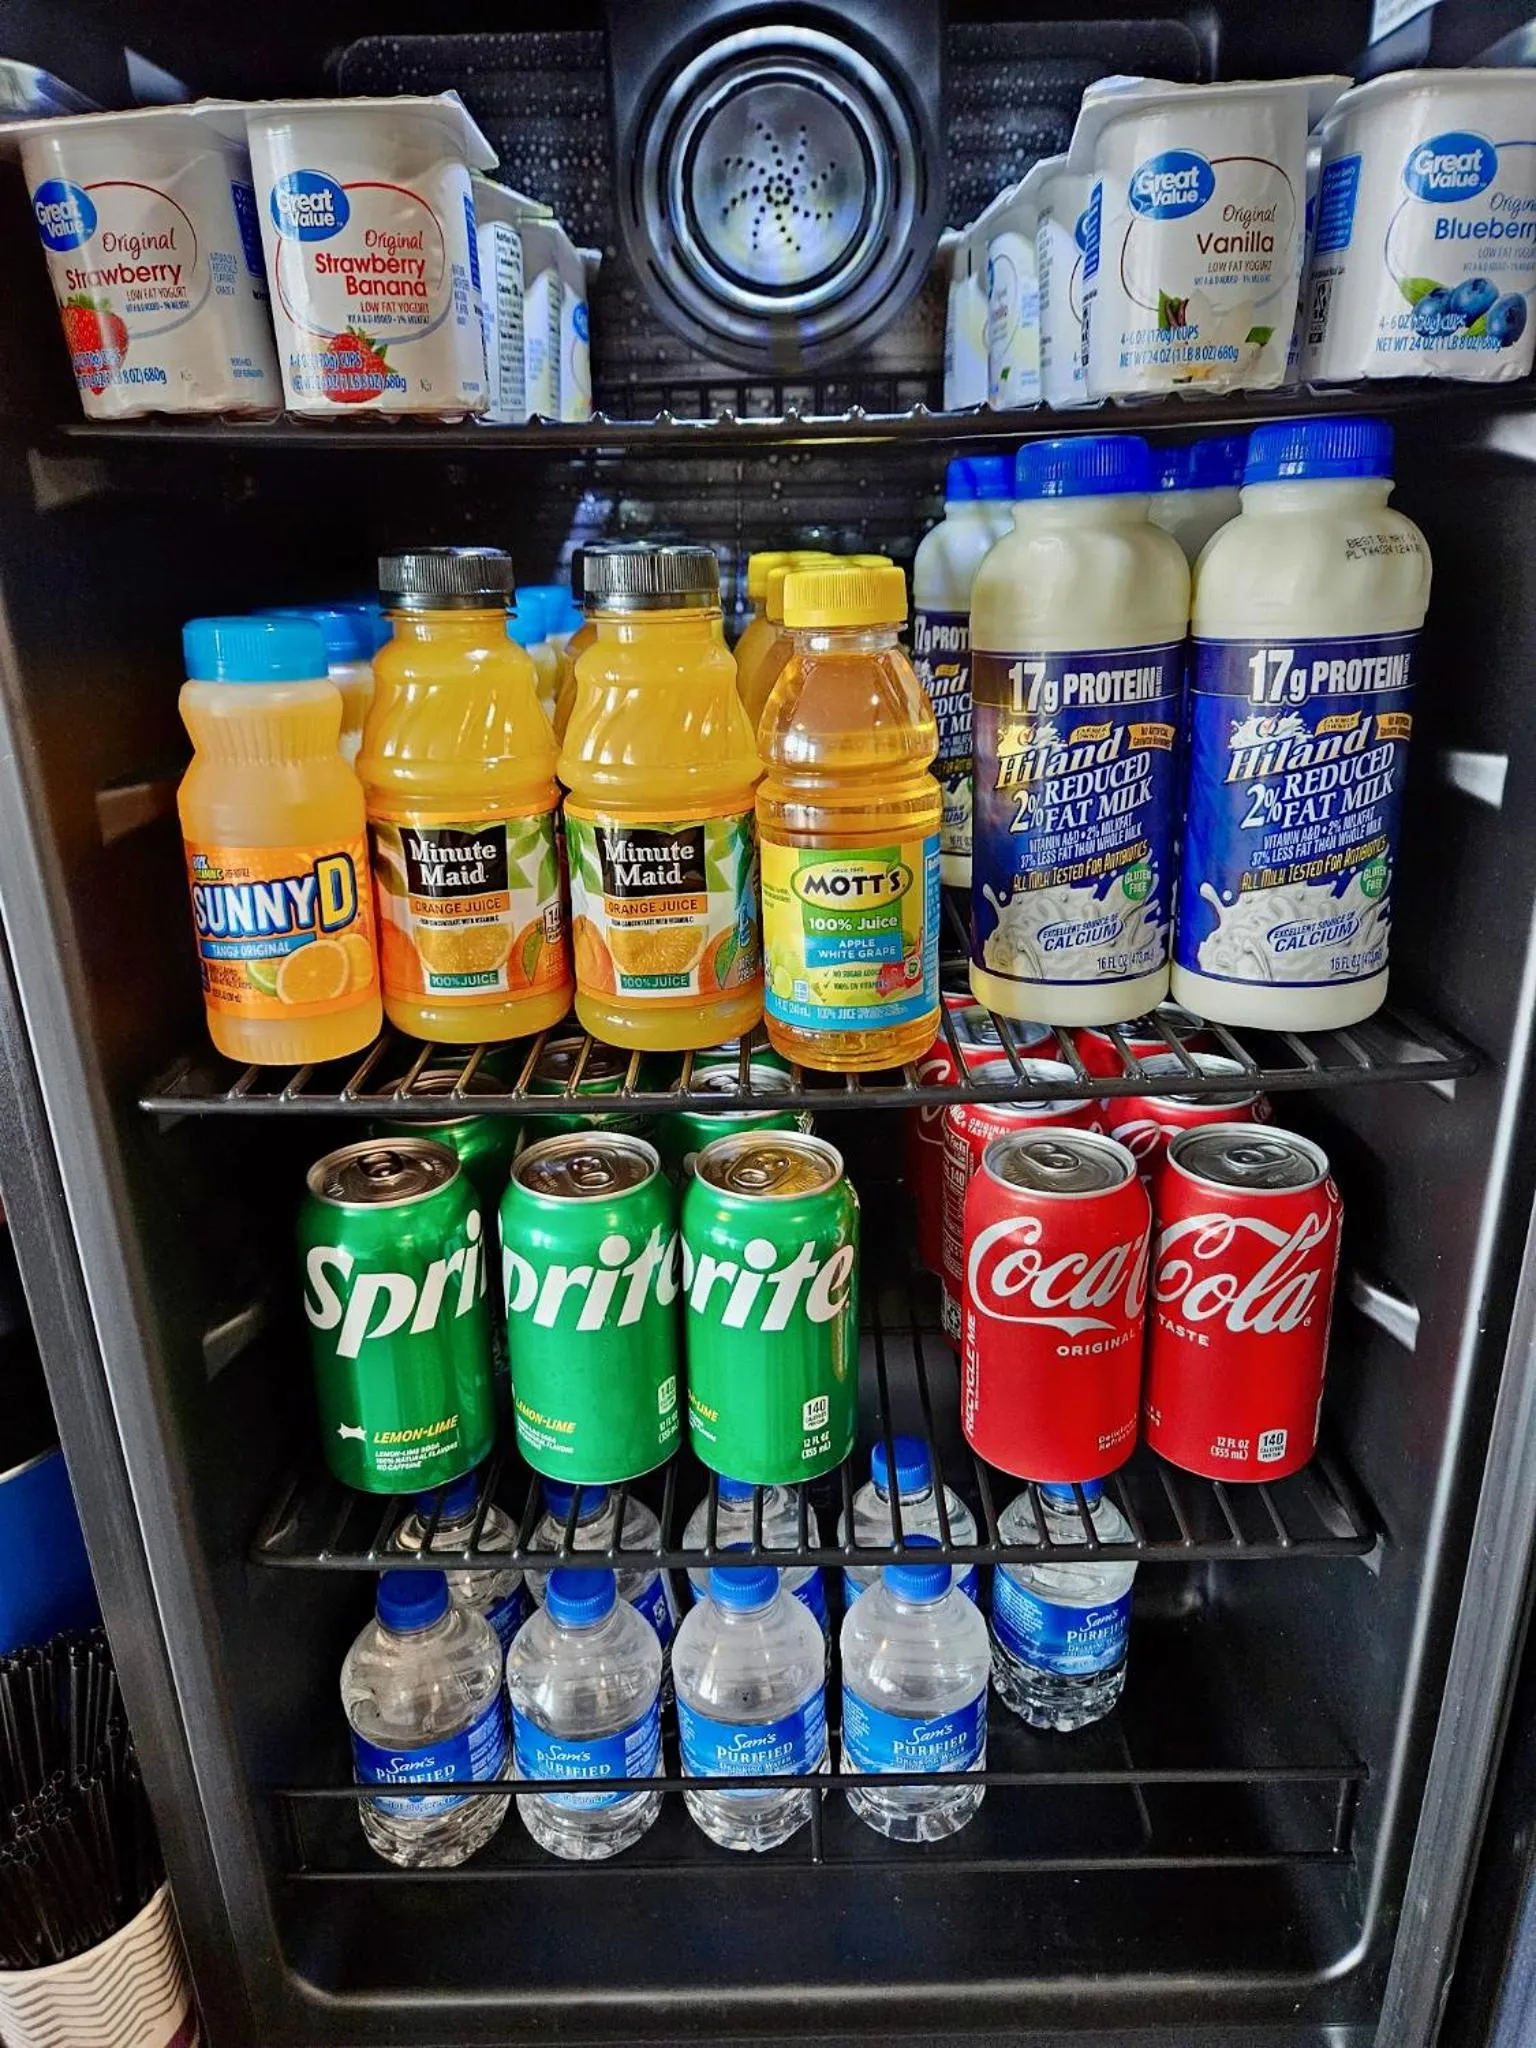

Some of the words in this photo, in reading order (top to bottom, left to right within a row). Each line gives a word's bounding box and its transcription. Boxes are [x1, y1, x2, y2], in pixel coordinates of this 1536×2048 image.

[1415, 149, 1483, 173] Great
[1138, 167, 1200, 193] Great
[1429, 172, 1479, 189] Value
[277, 188, 334, 213] Great
[1151, 186, 1199, 206] Value
[36, 195, 82, 225] Great
[289, 207, 336, 229] Value
[1223, 203, 1278, 229] Original
[102, 227, 178, 260] Original
[364, 228, 424, 256] Original
[1196, 231, 1275, 256] Vanilla
[65, 262, 183, 292] Strawberry
[315, 252, 426, 277] Strawberry
[1208, 261, 1228, 273] LOW
[1228, 261, 1243, 272] FAT
[1244, 260, 1273, 272] YOGURT
[126, 289, 141, 302] LOW
[157, 286, 187, 300] YOGURT
[346, 275, 428, 298] Banana
[361, 302, 380, 314] LOW
[382, 302, 397, 314] FAT
[398, 302, 430, 314] YOGURT
[1160, 348, 1171, 364] OZ
[1183, 347, 1194, 363] LB
[1195, 346, 1201, 361] 8
[1376, 337, 1392, 352] NET
[1409, 337, 1422, 351] 24
[1423, 337, 1435, 350] OZ
[144, 366, 167, 385] 680g
[932, 625, 968, 650] PROT
[1009, 661, 1059, 713] 17g
[1063, 667, 1156, 705] PROTEIN
[1249, 649, 1306, 704] 17g
[1310, 654, 1404, 694] PROTEIN
[994, 726, 1124, 790] Hiland
[1226, 714, 1373, 784] Hiland
[1043, 752, 1151, 806] REDUCED
[1282, 742, 1394, 803] REDUCED
[1042, 799, 1095, 835] FAT
[1096, 776, 1154, 821] MILK
[1240, 783, 1283, 831] 2%
[1281, 793, 1338, 830] FAT
[1340, 767, 1396, 814] MILK
[1009, 790, 1044, 834] 2%
[1061, 829, 1080, 848] A&D
[1086, 825, 1100, 841] 2%
[1251, 850, 1270, 867] 37%
[1272, 845, 1294, 864] LESS
[1295, 840, 1313, 859] FAT
[1314, 835, 1337, 855] THAN
[1338, 824, 1366, 847] WHOLE
[1264, 829, 1300, 851] VITAMIN
[1300, 824, 1321, 843] A&D
[1327, 818, 1342, 836] 2%
[409, 838, 497, 863] Minute
[604, 839, 695, 863] Minute
[1020, 854, 1036, 870] 37%
[1037, 849, 1057, 866] LESS
[1057, 844, 1073, 861] FAT
[1074, 840, 1096, 858] THAN
[1097, 830, 1124, 851] WHOLE
[421, 862, 487, 887] Maid
[615, 863, 683, 887] Maid
[1052, 862, 1085, 886] TESTED
[1086, 858, 1103, 878] FOR
[1288, 858, 1323, 883] TESTED
[1324, 853, 1344, 874] FOR
[803, 870, 902, 896] MOTT'S
[415, 900, 462, 914] ORANGE
[465, 897, 501, 913] JUICE
[608, 901, 656, 914] ORANGE
[659, 899, 698, 912] JUICE
[809, 916, 853, 931] 100%
[858, 915, 898, 931] Juice
[1042, 923, 1082, 939] EXCELLENT
[1274, 922, 1316, 939] EXCELLENT
[241, 940, 292, 957] ORIGINAL
[839, 938, 875, 950] APPLE
[1043, 922, 1117, 952] CALCIUM
[1274, 921, 1354, 953] CALCIUM
[818, 949, 855, 960] WHITE
[858, 945, 896, 958] GRAPE
[1096, 957, 1107, 971] 16
[1108, 956, 1117, 969] FL
[1330, 957, 1340, 971] 16
[1341, 957, 1350, 970] FL
[432, 975, 460, 987] 100%
[461, 973, 498, 986] JUICE
[622, 977, 651, 988] 100%
[653, 975, 688, 987] JUICE
[498, 1222, 679, 1331] prit
[1154, 1209, 1332, 1335] Cola
[967, 1311, 976, 1345] ME
[1158, 1313, 1209, 1348] TASTE
[1056, 1330, 1136, 1357] ORIGINAL
[966, 1344, 976, 1438] RECYCLE
[516, 1397, 577, 1434] LEMON-LIME
[808, 1399, 826, 1416] 140
[373, 1414, 459, 1444] LEMON-LIME
[1263, 1432, 1284, 1447] 140
[1210, 1444, 1229, 1458] (355
[1231, 1449, 1249, 1461] mL)
[1217, 1435, 1226, 1447] 12
[1227, 1437, 1236, 1449] FL
[1238, 1439, 1250, 1450] OZ
[1080, 1609, 1119, 1633] Sam's
[732, 1732, 777, 1751] Sam's
[893, 1732, 968, 1758] PURIFIED
[907, 1723, 954, 1745] Sam's
[385, 1755, 436, 1776] Sam's
[536, 1749, 612, 1778] PURIFIED
[549, 1745, 592, 1762] Sam's
[716, 1742, 794, 1765] PURIFIED
[895, 1753, 940, 1770] DRINKING
[718, 1760, 764, 1776] DRINKING
